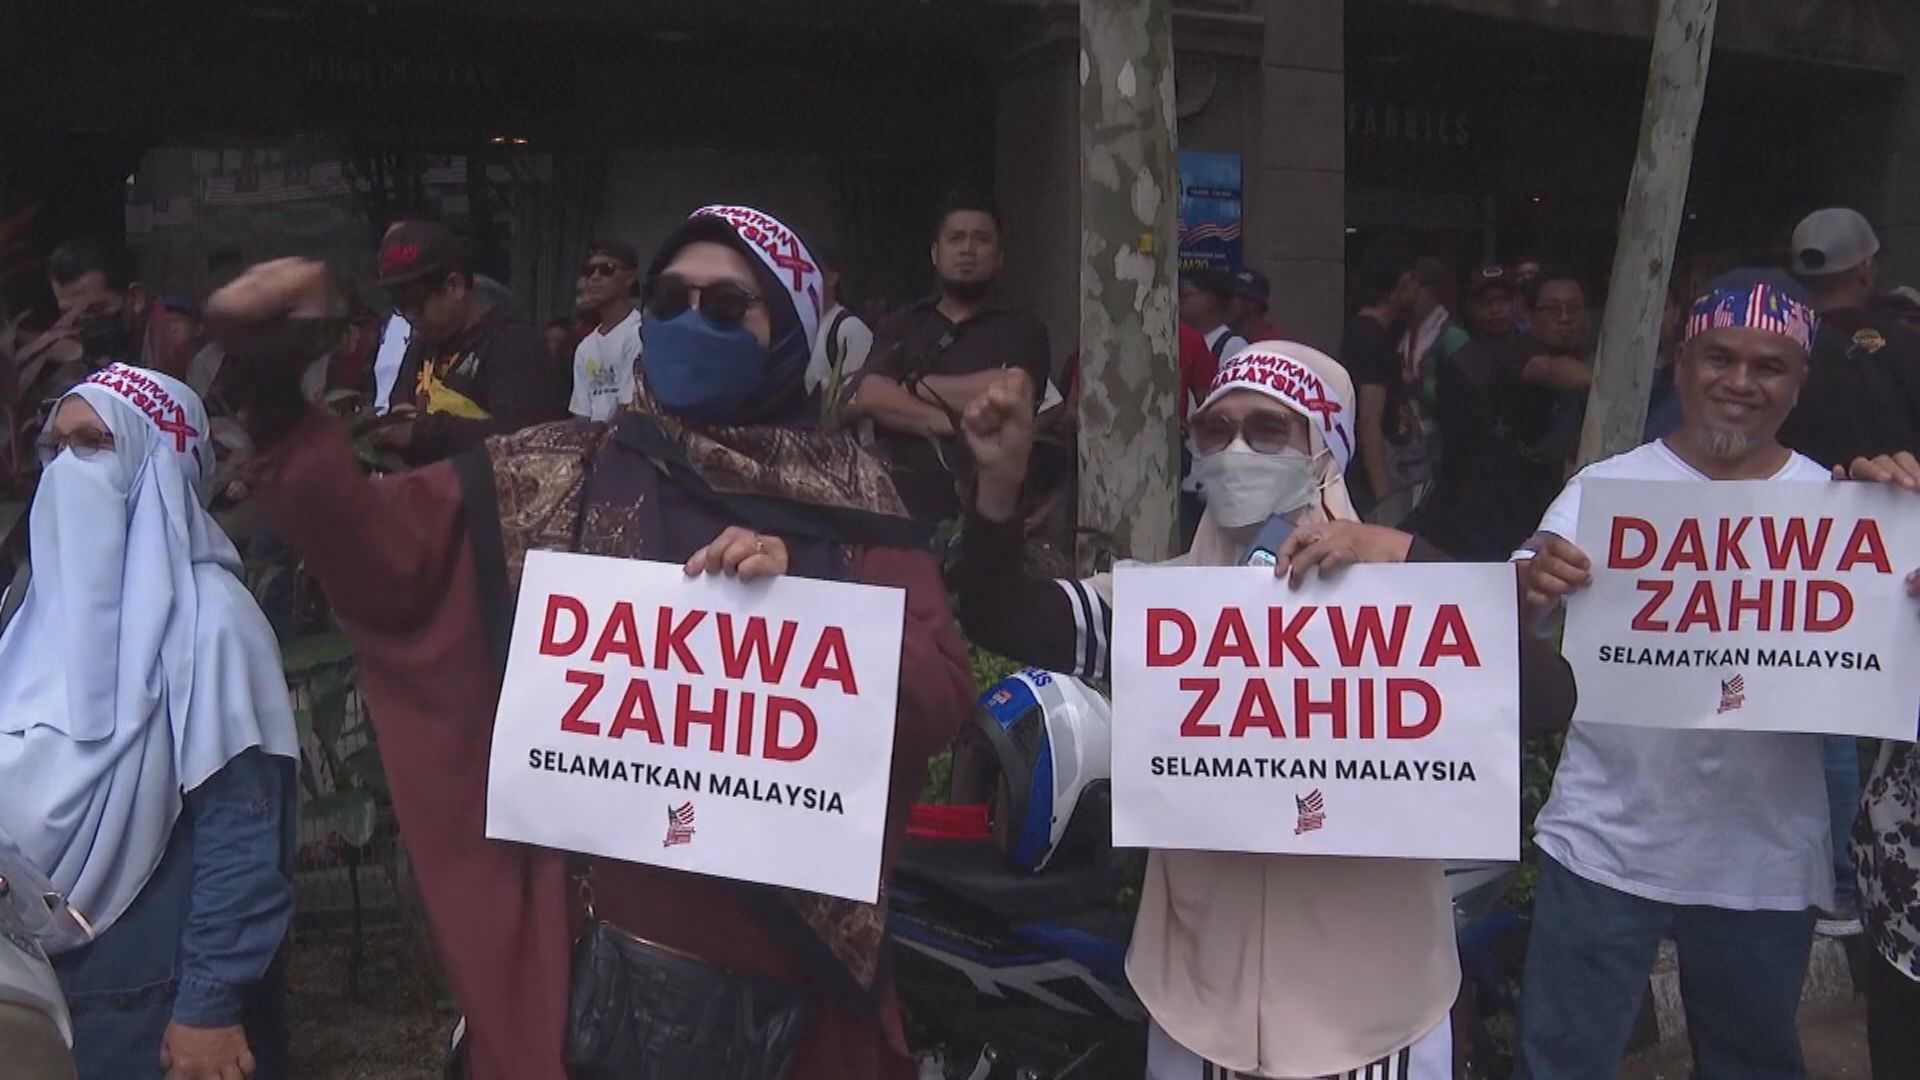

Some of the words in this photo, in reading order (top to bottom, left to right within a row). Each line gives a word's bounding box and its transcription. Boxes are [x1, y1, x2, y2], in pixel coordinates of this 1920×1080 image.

[1610, 517, 1892, 573] DAKWA
[1145, 604, 1480, 668] DAKWA
[1631, 578, 1853, 632] ZAHID
[538, 592, 858, 695] DAKWA
[1599, 645, 1750, 668] SELAMATKAN
[1757, 649, 1882, 672] MALAYSIA
[559, 668, 817, 762] ZAHID
[1178, 676, 1442, 740] ZAHID
[529, 747, 701, 792] SELAMATKAN
[708, 773, 845, 815] MALAYSIA
[1150, 755, 1327, 780] SELAMATKAN
[1335, 759, 1477, 782] MALAYSIA
